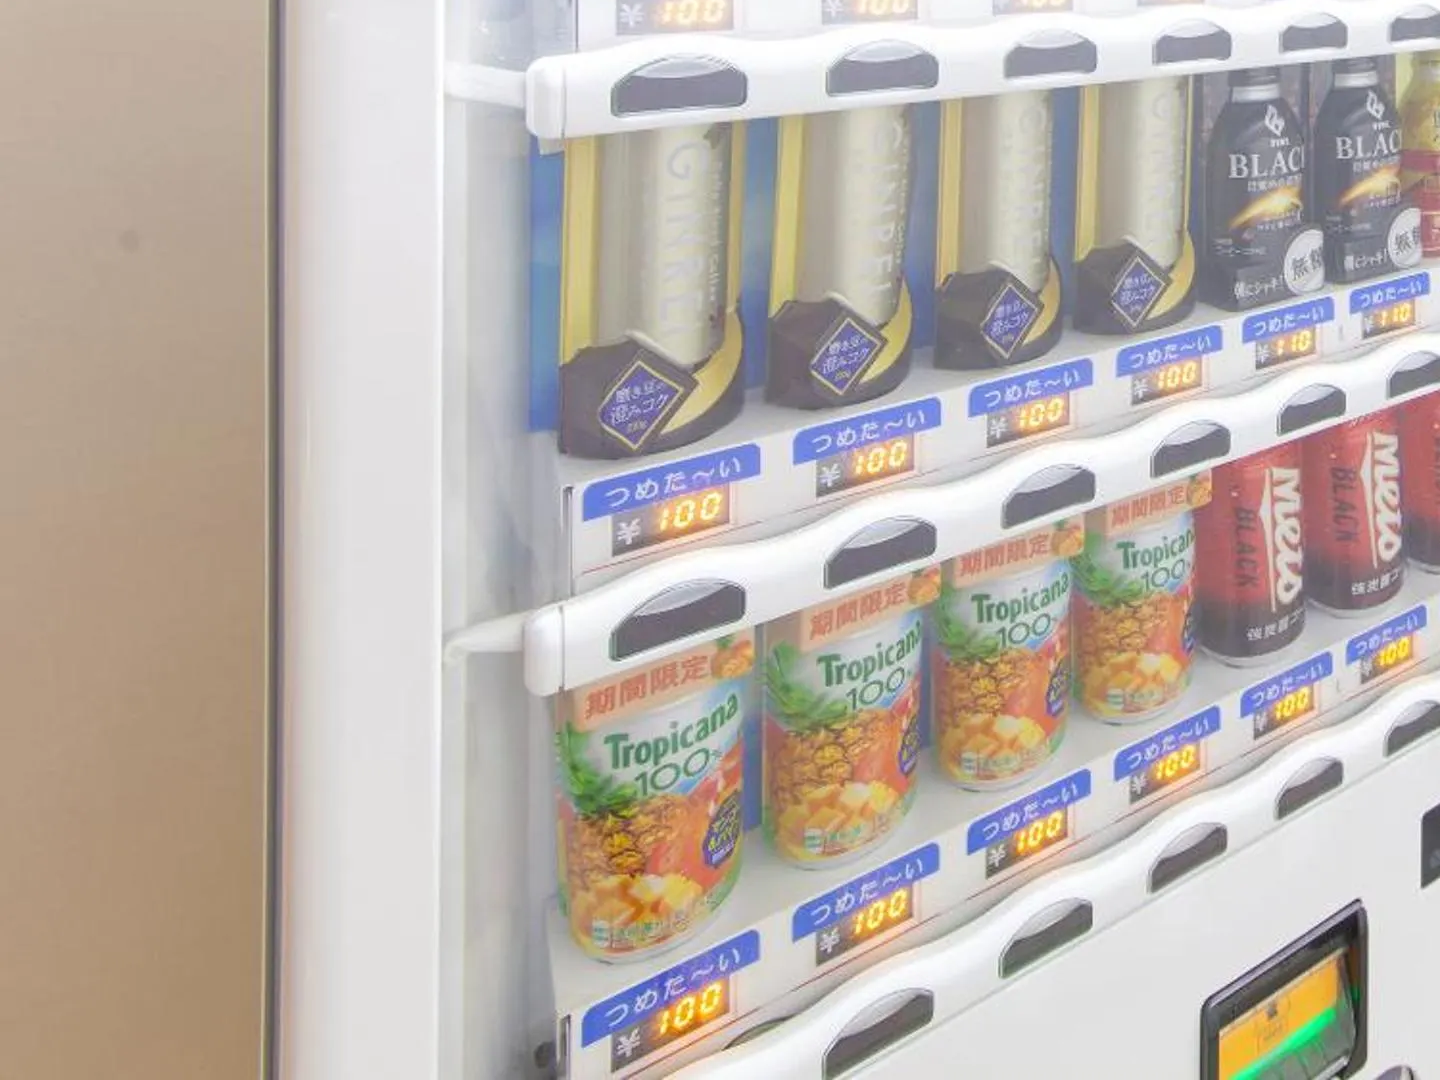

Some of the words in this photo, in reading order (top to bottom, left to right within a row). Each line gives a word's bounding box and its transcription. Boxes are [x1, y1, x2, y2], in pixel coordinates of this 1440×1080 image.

[1229, 145, 1305, 179] BLAC
[1380, 303, 1411, 326] 110
[1277, 330, 1311, 356] 110
[1158, 360, 1197, 388] 100
[811, 409, 926, 453] つめた〜い
[1019, 397, 1063, 429] 100
[855, 440, 908, 476] 100
[604, 457, 741, 508] つめた〜い
[1330, 467, 1358, 542] BLACK
[659, 492, 723, 532] 100
[958, 533, 1051, 578] 期間限定
[1232, 506, 1261, 588] BLACK
[810, 581, 907, 641] 期間限定
[1379, 637, 1409, 665] 100
[584, 655, 711, 719] 期間限定
[1275, 687, 1309, 719] 100
[604, 692, 739, 771] Tropicana
[1156, 745, 1195, 781] 100
[1016, 811, 1062, 853] 100
[811, 859, 923, 924] つめた〜い
[853, 889, 907, 935] 100
[606, 949, 739, 1027] つめた〜い
[657, 981, 723, 1036] 100
